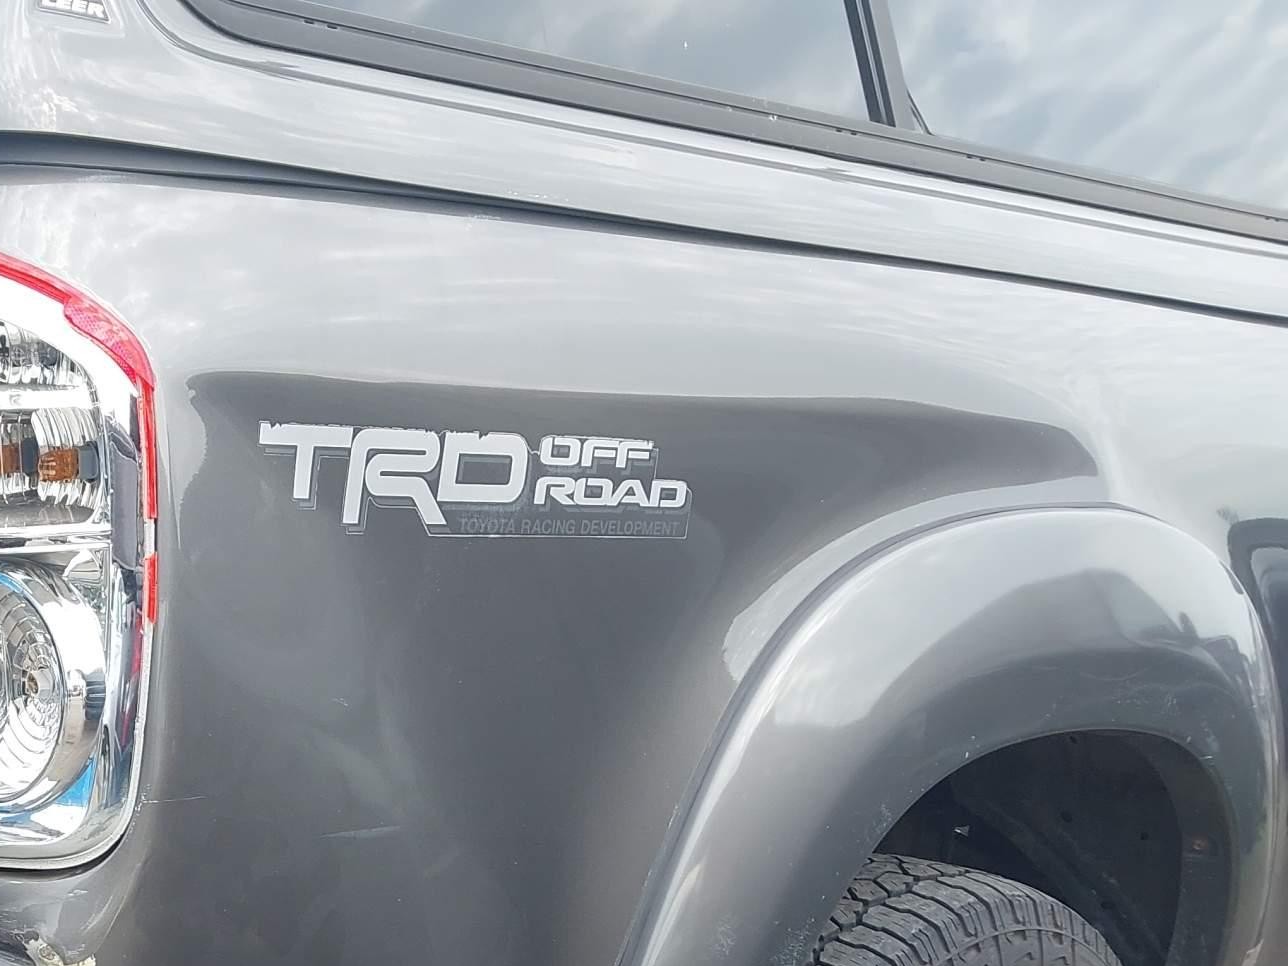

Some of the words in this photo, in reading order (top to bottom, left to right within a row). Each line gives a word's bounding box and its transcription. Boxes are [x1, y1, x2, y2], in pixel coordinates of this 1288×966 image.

[539, 437, 654, 468] OFF
[258, 422, 528, 526] TRD
[533, 476, 688, 508] ROAD
[457, 517, 514, 534] TOYOTA
[520, 519, 576, 536] RACING
[580, 520, 681, 536] DEVELOPMENT
